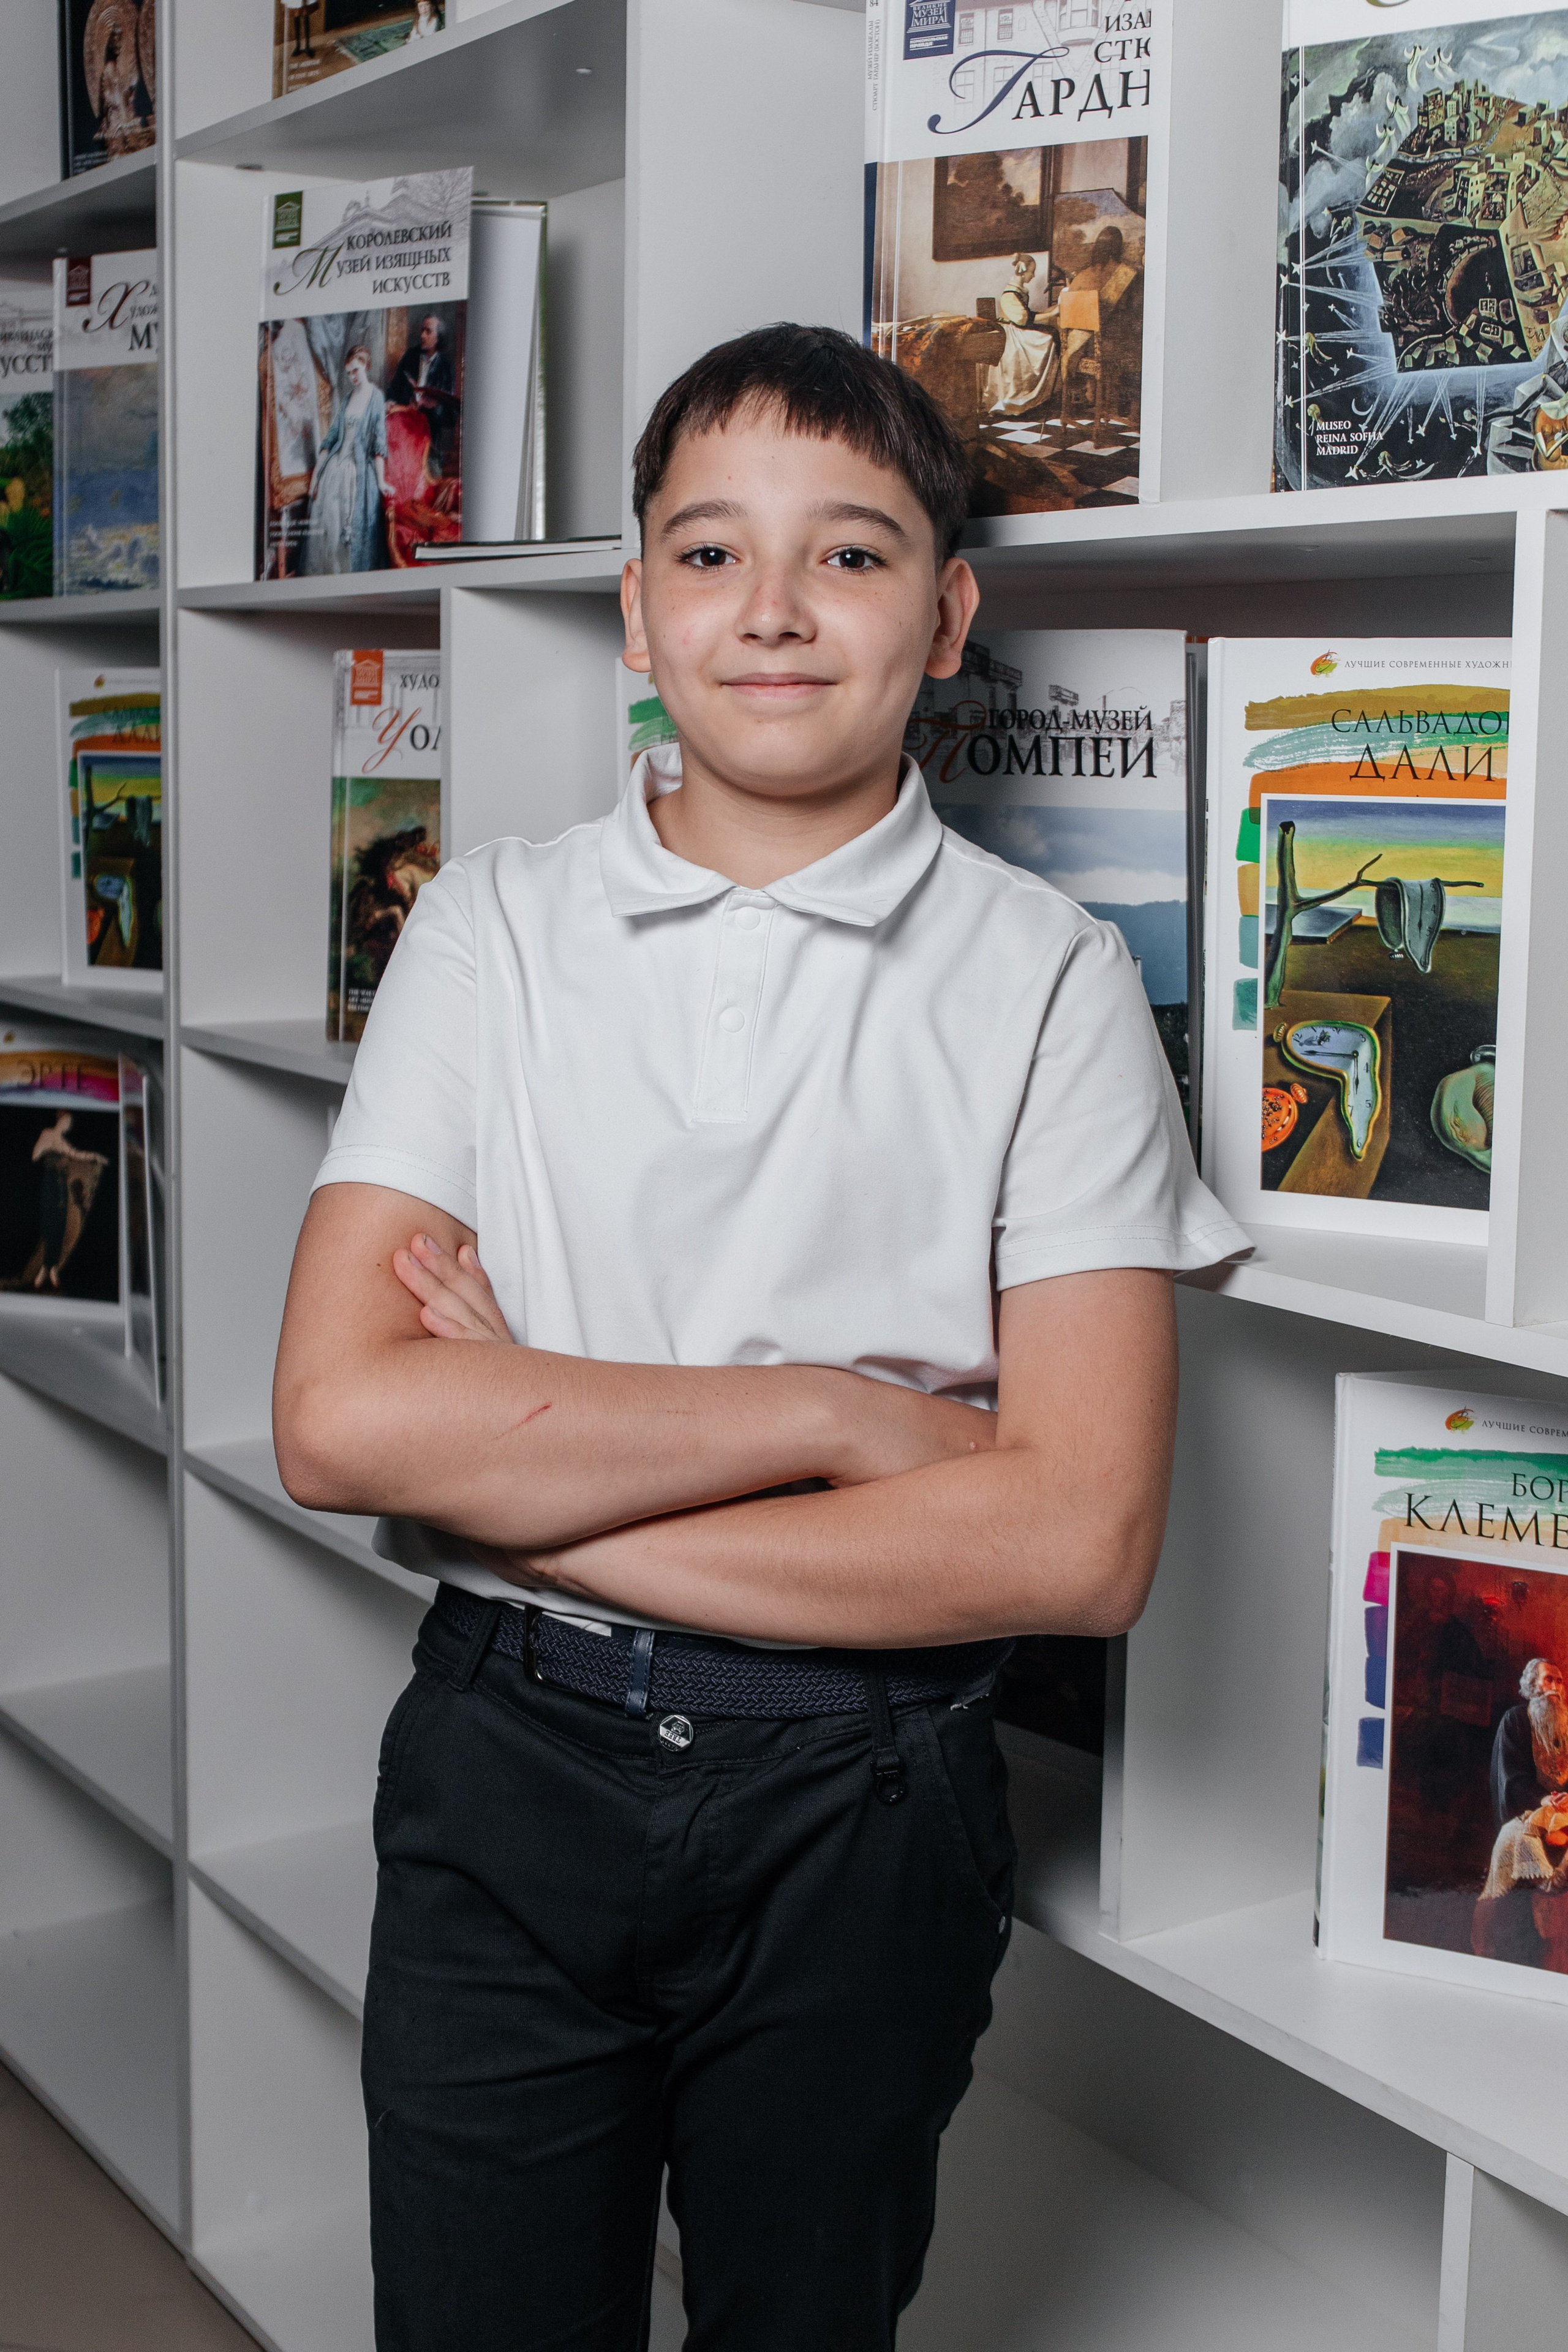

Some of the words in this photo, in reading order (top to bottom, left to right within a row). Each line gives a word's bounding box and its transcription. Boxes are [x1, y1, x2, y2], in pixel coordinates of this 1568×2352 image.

[913, 2, 948, 11] ВЕЛИКИЕ
[913, 8, 944, 18] МУЗЕИ
[913, 15, 945, 26] МИРА
[346, 220, 452, 251] КОРОЛЕВСКИЙ
[273, 241, 369, 295] МУЗЕЙ
[375, 246, 451, 271] ИЗЯЩНЫХ
[372, 271, 451, 295] ИСКУССТВ
[0, 353, 53, 379] УССТ
[1316, 420, 1351, 431] MUSEO
[1316, 432, 1348, 443] REINA
[1316, 445, 1359, 456] MADRID
[1344, 660, 1386, 669] ЛУЧШИЕ
[1389, 660, 1462, 669] СОВРЕМЕННЫЕ
[1464, 660, 1512, 669] ХУДОЖН
[988, 705, 1153, 734] ГОРОД-МУЗЕЙ
[1332, 709, 1509, 737] САЛЬВАДО
[1349, 744, 1496, 783] ДАЛИ
[1363, 1062, 1370, 1073] 4
[1365, 1099, 1373, 1109] 5
[1356, 1138, 1362, 1148] 6
[1482, 1420, 1526, 1433] ЛУЧШИЕ
[1404, 1491, 1568, 1550] КЛЕМЕ
